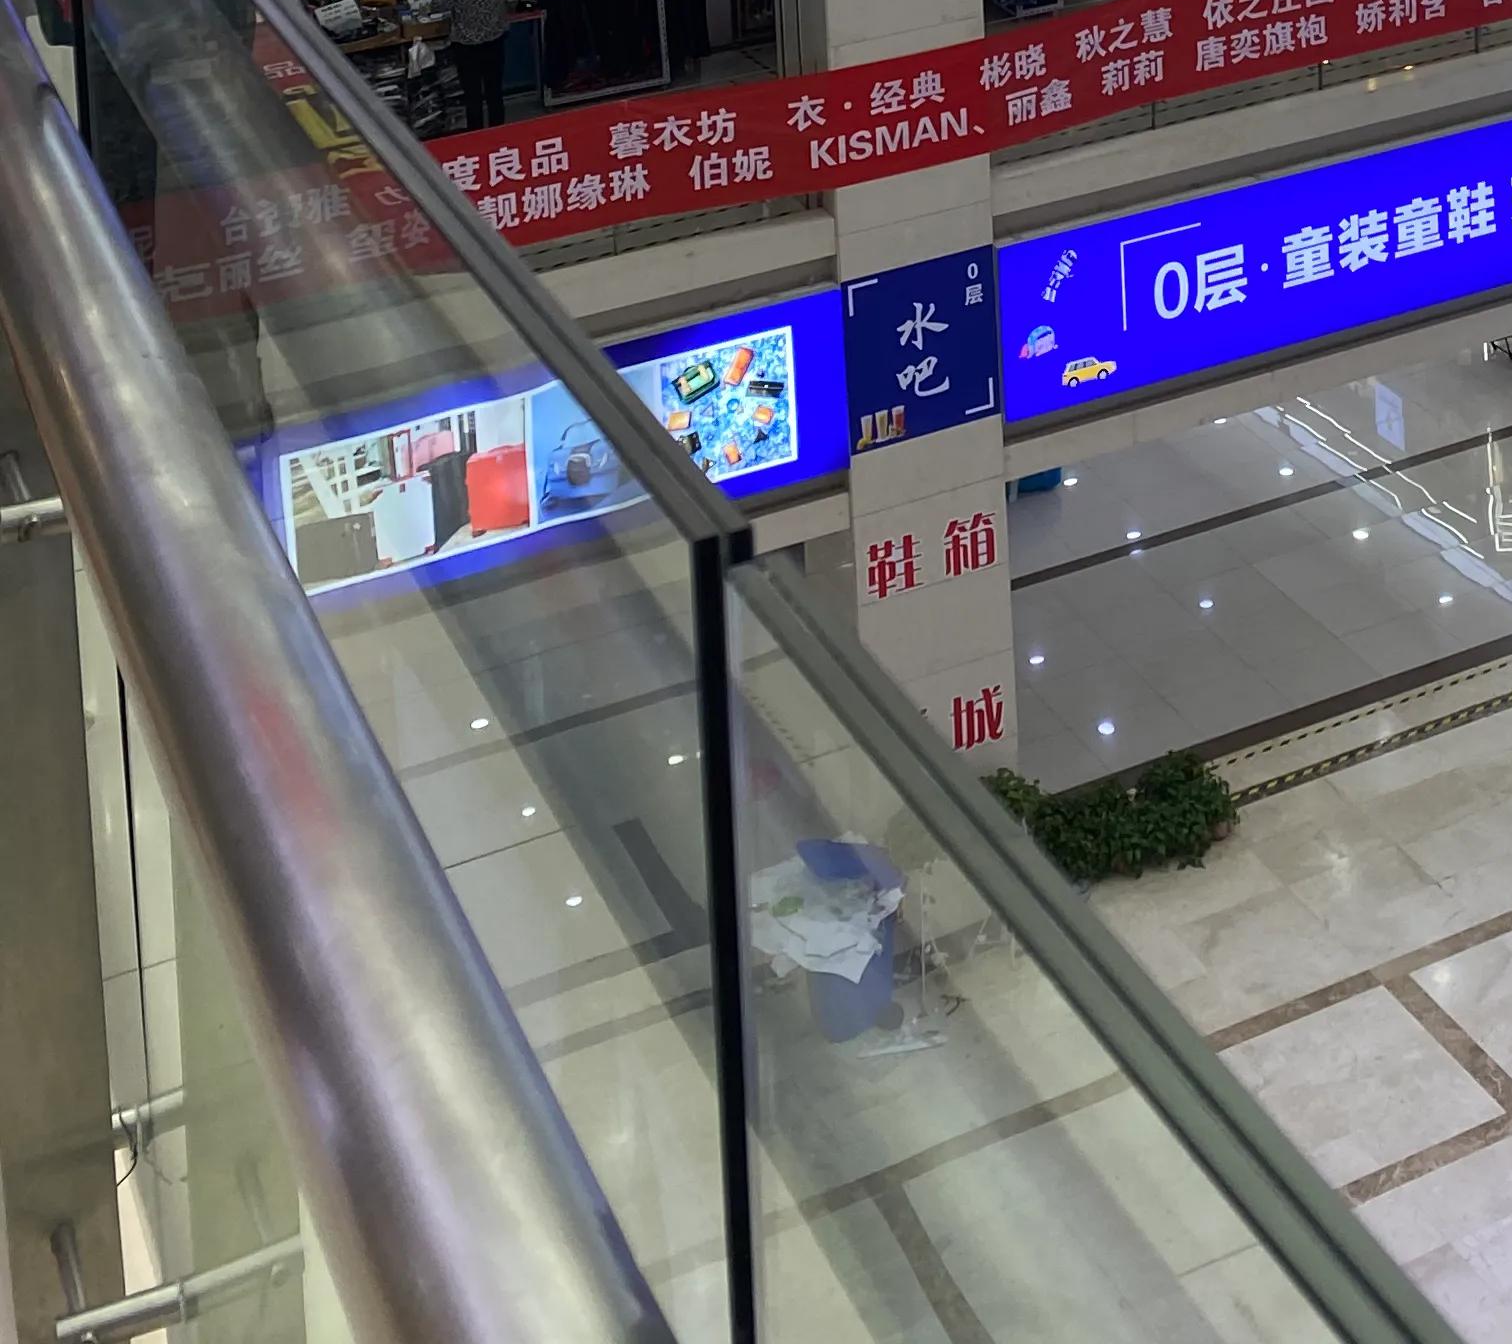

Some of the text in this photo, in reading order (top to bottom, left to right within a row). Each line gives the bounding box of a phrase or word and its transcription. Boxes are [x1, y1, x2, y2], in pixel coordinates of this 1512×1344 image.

[609, 108, 737, 159] 馨衣坊
[979, 43, 1047, 92] 彬晓
[1075, 6, 1174, 64] 秋之慧
[689, 146, 774, 192] 伯妮
[1006, 78, 1073, 127] 丽鑫
[1101, 49, 1165, 97] 莉莉
[1196, 13, 1329, 72] 唐奕旗袍
[895, 301, 951, 399] 水吧
[866, 511, 997, 600] 鞋箱
